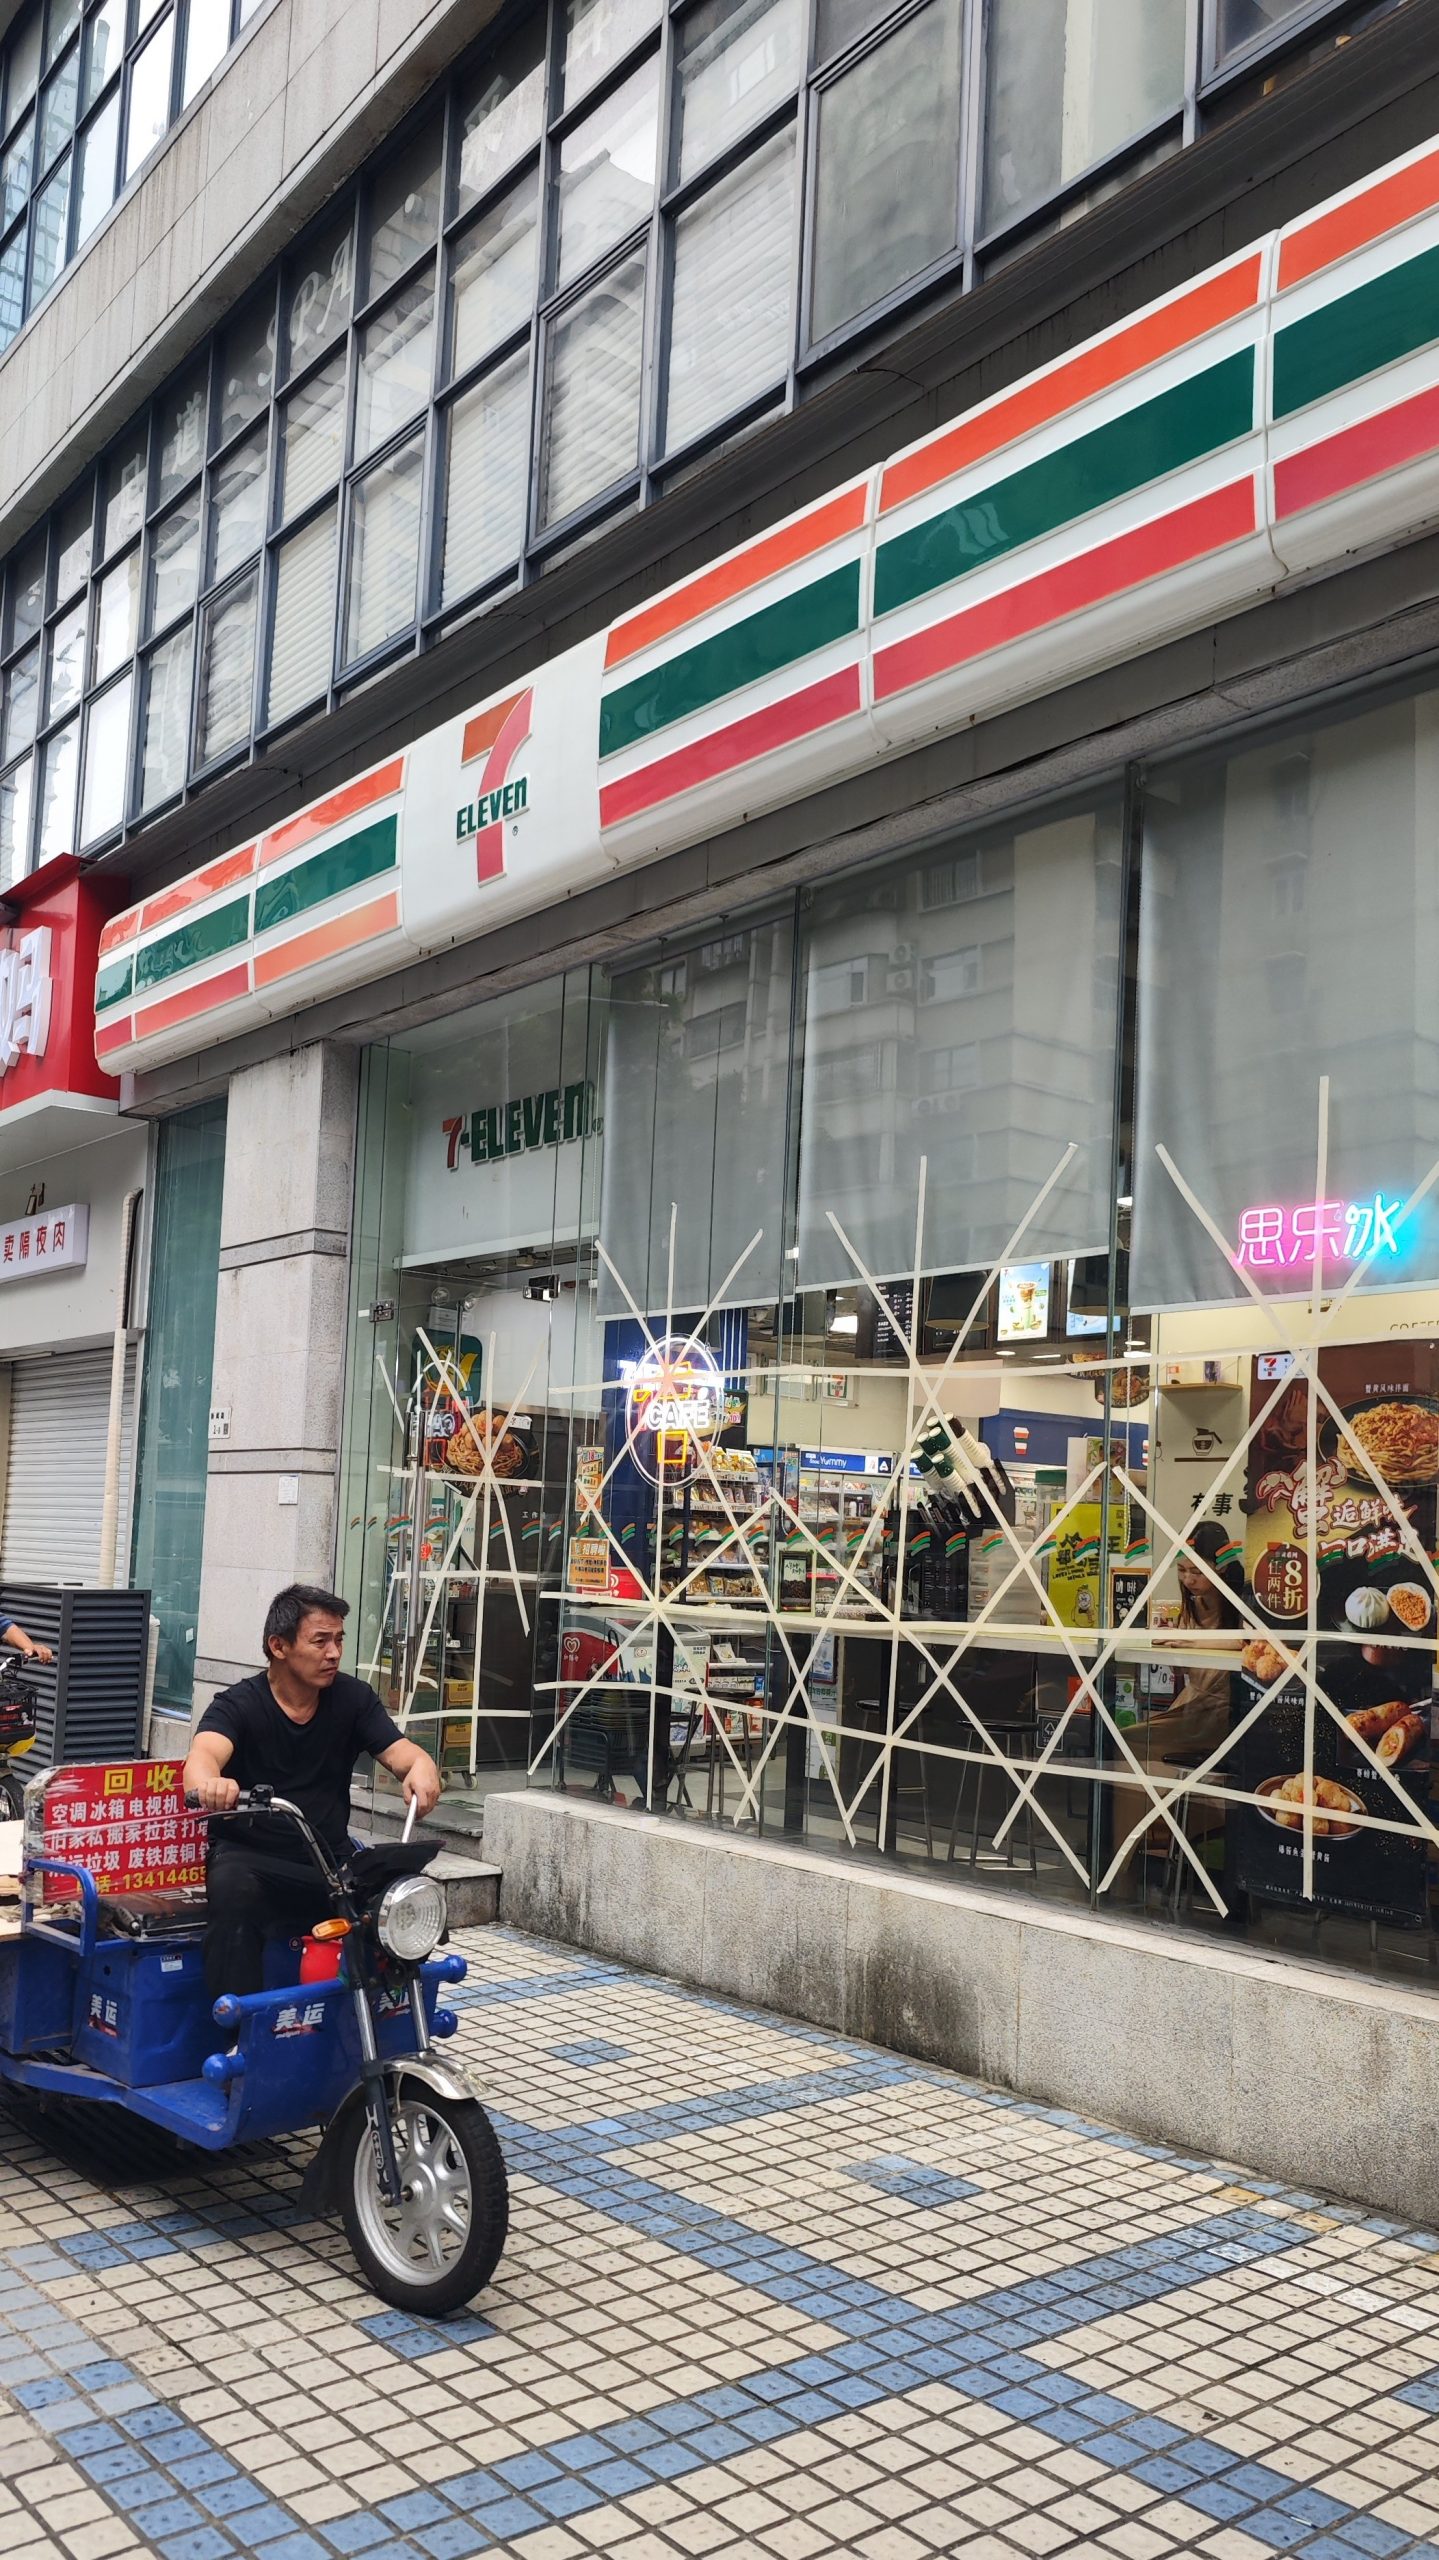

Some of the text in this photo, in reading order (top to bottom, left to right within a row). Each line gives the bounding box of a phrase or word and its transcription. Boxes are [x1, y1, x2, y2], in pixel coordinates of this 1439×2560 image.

[462, 686, 533, 886] 7
[3, 1221, 66, 1263] 卖隔夜肉
[1238, 1193, 1400, 1264] 思乐冰
[820, 1455, 847, 1470] Yummy
[1283, 1559, 1305, 1611] 8折
[103, 1765, 177, 1796] 回收
[90, 1993, 118, 2026] 美运
[274, 2002, 326, 2032] 美运
[377, 1989, 411, 2013] 美
